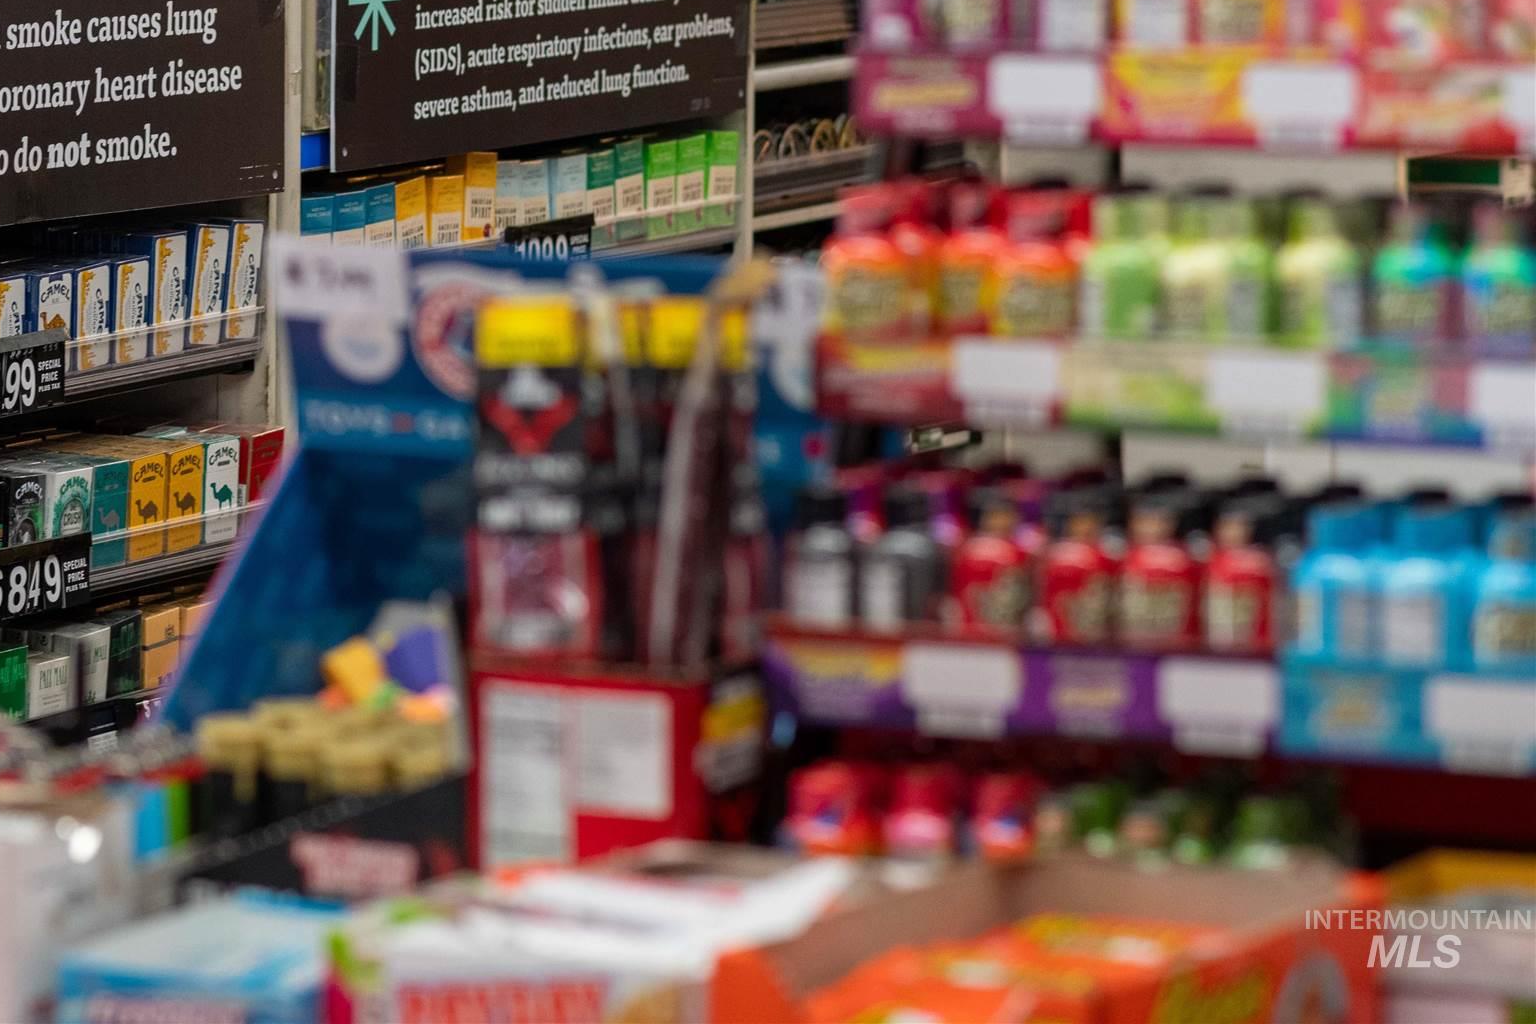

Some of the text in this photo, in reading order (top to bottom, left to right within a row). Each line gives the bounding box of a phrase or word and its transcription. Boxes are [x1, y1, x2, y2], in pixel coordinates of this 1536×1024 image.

[6, 10, 82, 50] smoke
[88, 13, 161, 43] causes
[166, 1, 218, 44] lung
[416, 17, 734, 80] (SIDS), acute respiratory infections, ear problems,
[94, 68, 157, 103] heart
[162, 60, 243, 97] disease
[414, 61, 690, 120] severe asthma, and reduced lung function.
[14, 136, 42, 173] do
[47, 133, 90, 169] not
[96, 124, 177, 164] smoke.
[41, 283, 72, 304] CAMEL
[37, 356, 62, 372] SPECIAL
[38, 381, 62, 394] PLUS TAX
[40, 370, 59, 383] PRICE
[172, 452, 202, 476] CAMEL
[208, 444, 238, 467] CAMEL
[62, 556, 88, 572] SPECIAL
[65, 581, 89, 594] PLUS TAX
[67, 570, 86, 583] PRICE
